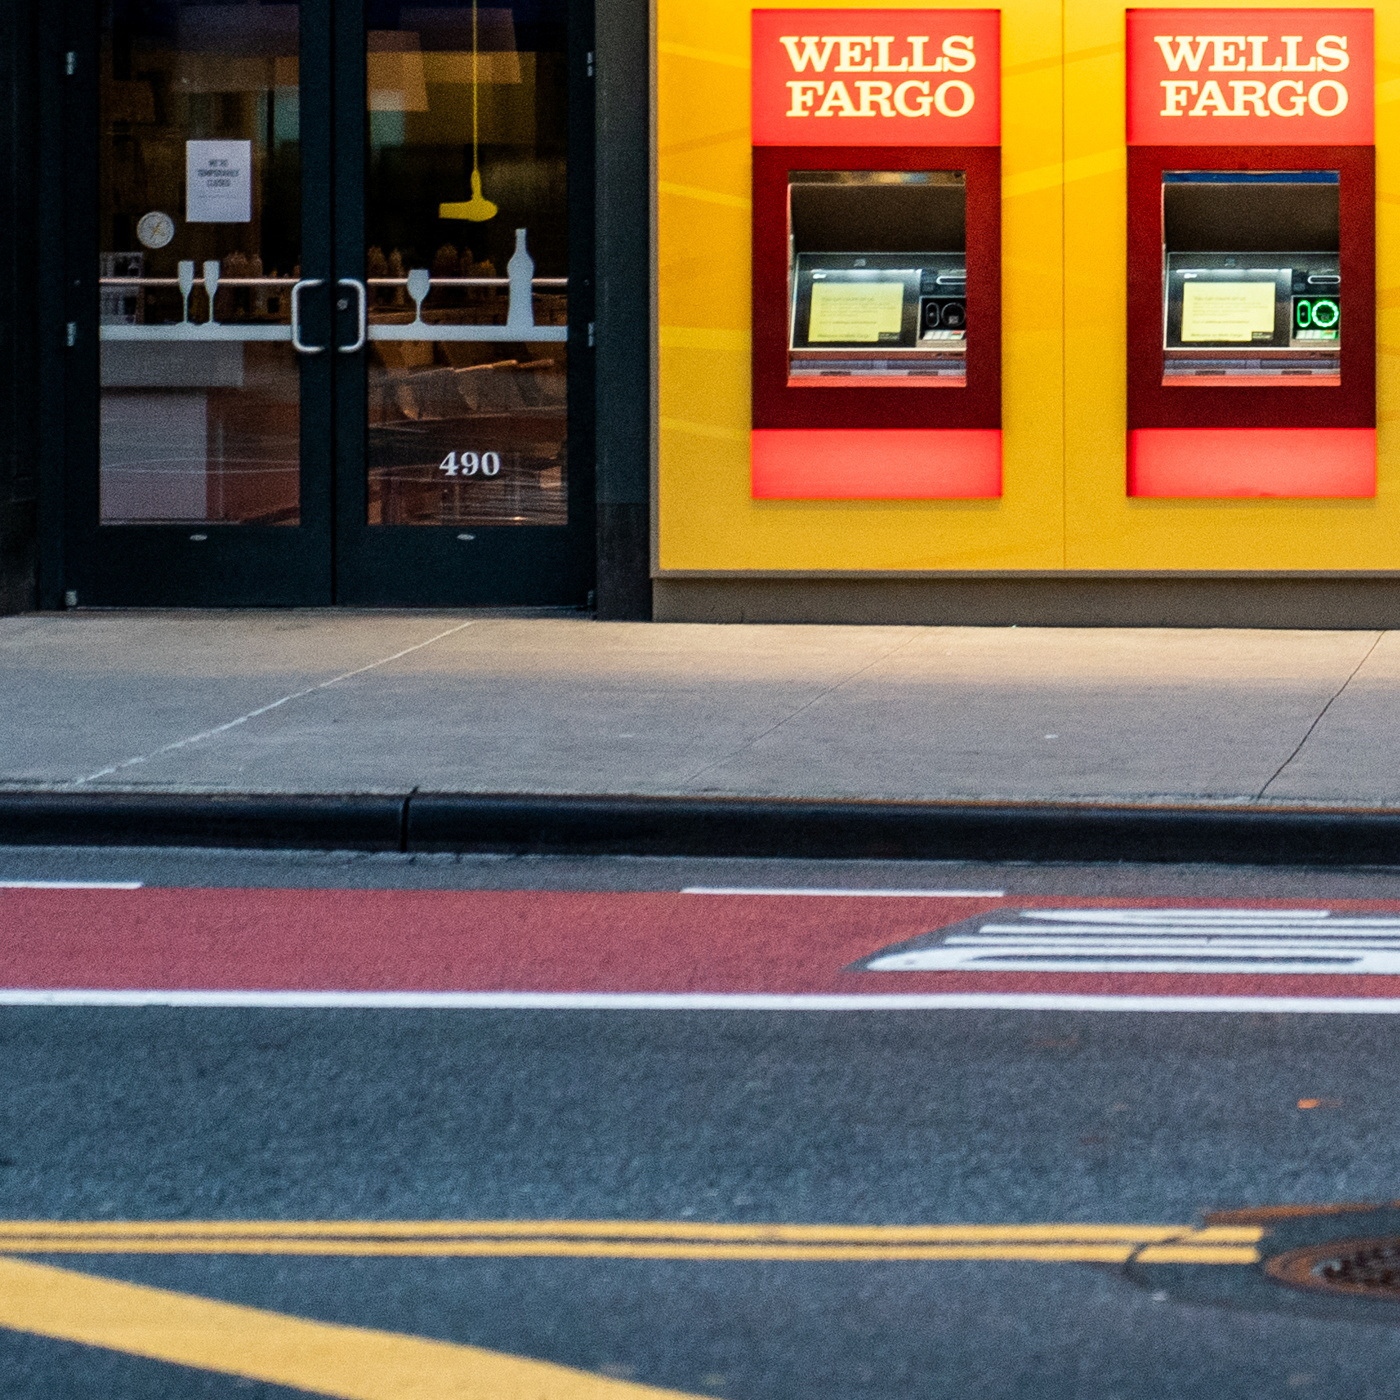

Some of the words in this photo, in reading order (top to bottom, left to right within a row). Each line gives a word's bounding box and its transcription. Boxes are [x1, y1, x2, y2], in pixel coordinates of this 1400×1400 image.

[781, 35, 976, 73] WELLS
[1154, 35, 1349, 73] WELLS
[786, 80, 975, 118] FARGO
[1159, 80, 1348, 118] FARGO
[438, 451, 502, 478] 490
